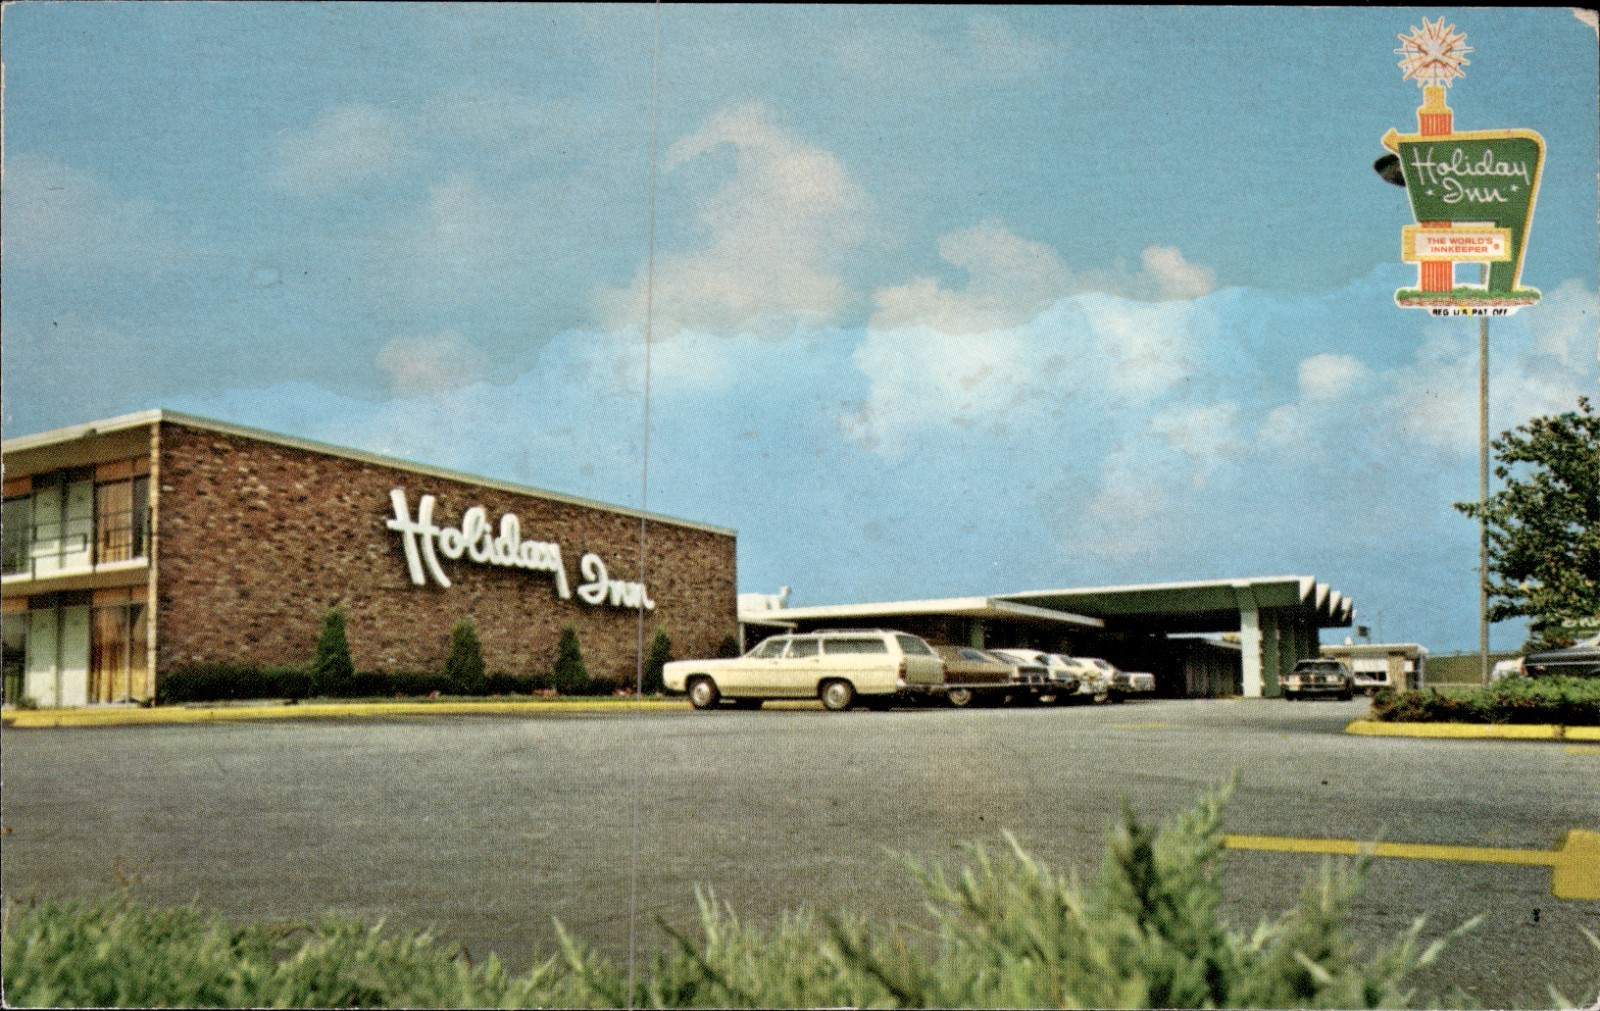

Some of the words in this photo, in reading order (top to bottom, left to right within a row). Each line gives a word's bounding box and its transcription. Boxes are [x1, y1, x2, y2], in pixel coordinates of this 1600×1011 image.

[1411, 147, 1530, 186] Holiday
[1442, 177, 1508, 203] Inn
[386, 488, 572, 600] Holiday
[577, 553, 656, 610] Inn
